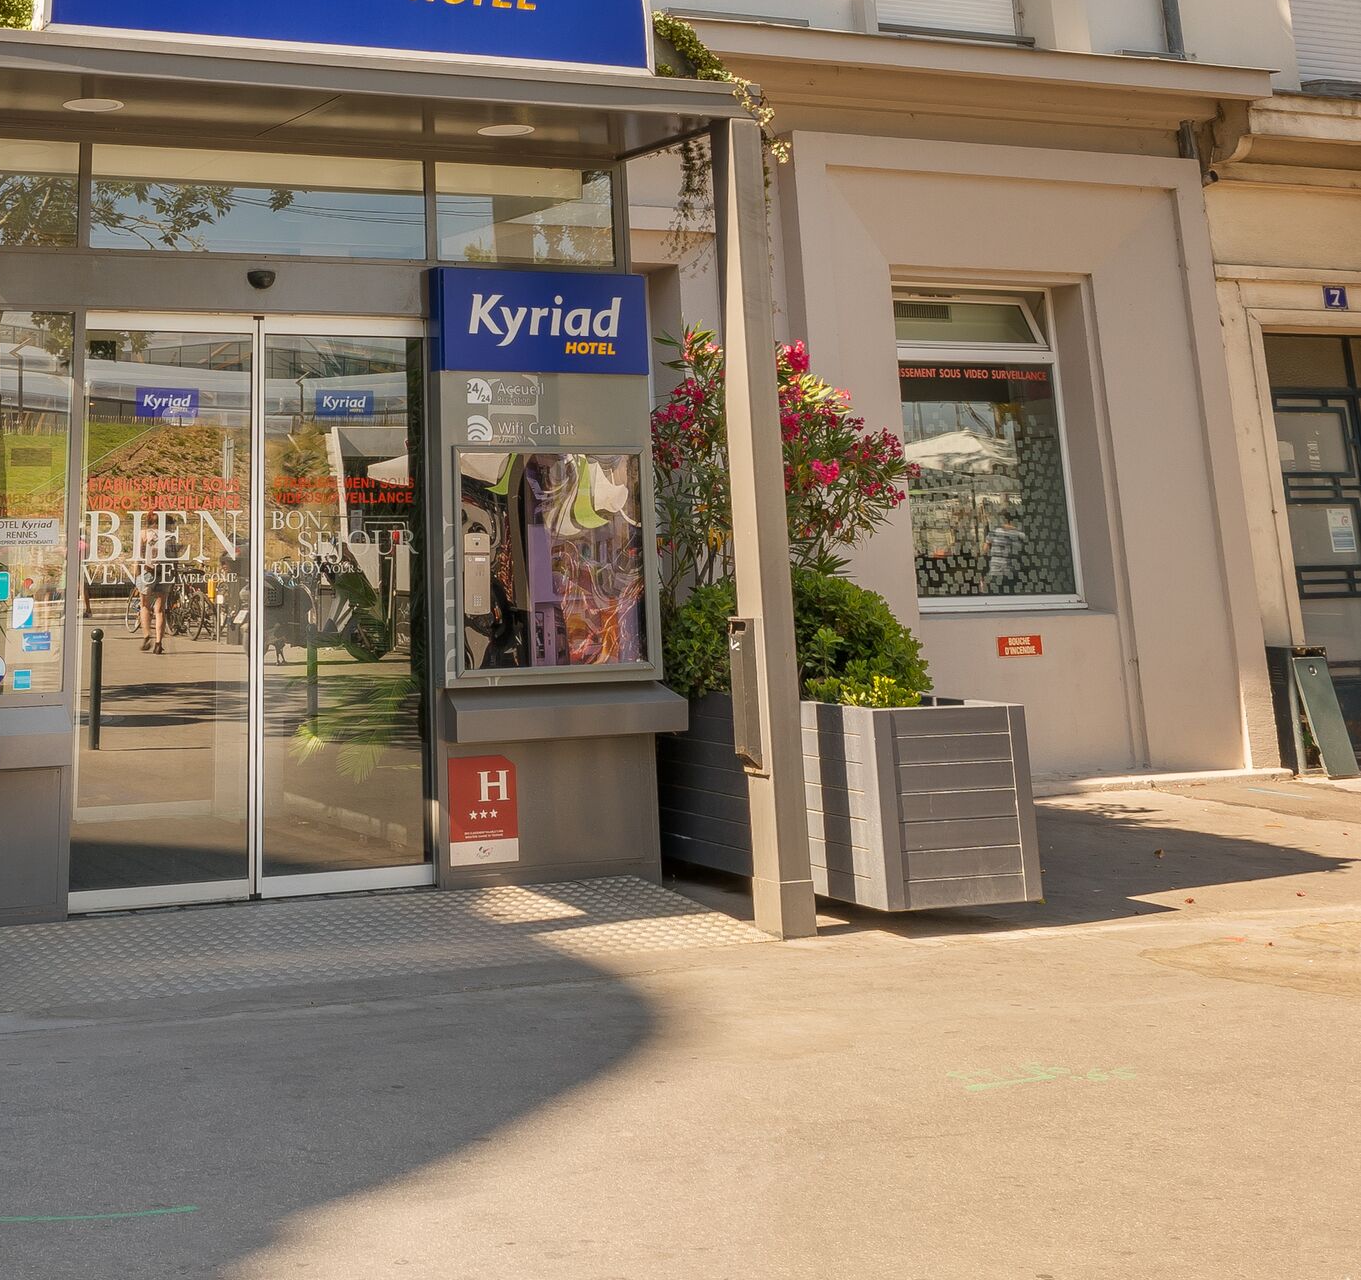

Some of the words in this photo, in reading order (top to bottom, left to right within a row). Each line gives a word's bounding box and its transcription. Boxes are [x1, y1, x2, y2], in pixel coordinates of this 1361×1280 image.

[1329, 288, 1342, 307] 7
[468, 293, 623, 347] Kyriad
[565, 341, 616, 355] HOTEL
[940, 368, 961, 378] SOUS
[964, 369, 989, 379] VIDEO
[991, 369, 1048, 381] SURVEILLANCE
[497, 381, 544, 396] Accueil
[143, 394, 192, 410] Kyriad
[323, 395, 367, 410] Kyriad
[497, 421, 524, 435] Wifi
[528, 421, 576, 436] Gratuit
[87, 476, 195, 493] ETABLISSEMENT
[202, 477, 240, 492] SOUS
[88, 495, 132, 510] VIDEO
[140, 494, 241, 510] SURVEILLANCE
[21, 520, 53, 531] Kyriad
[270, 510, 322, 530] BON
[6, 531, 38, 539] RENNES
[82, 510, 244, 562] BIEN
[297, 523, 419, 565] SÉJOUR
[80, 563, 176, 585] VENUE
[178, 572, 238, 583] WELCOME
[272, 561, 325, 579] ENJOY
[1008, 637, 1031, 646] BOUCHE
[1005, 645, 1036, 655] D'INCENDIE
[477, 769, 510, 802] H
